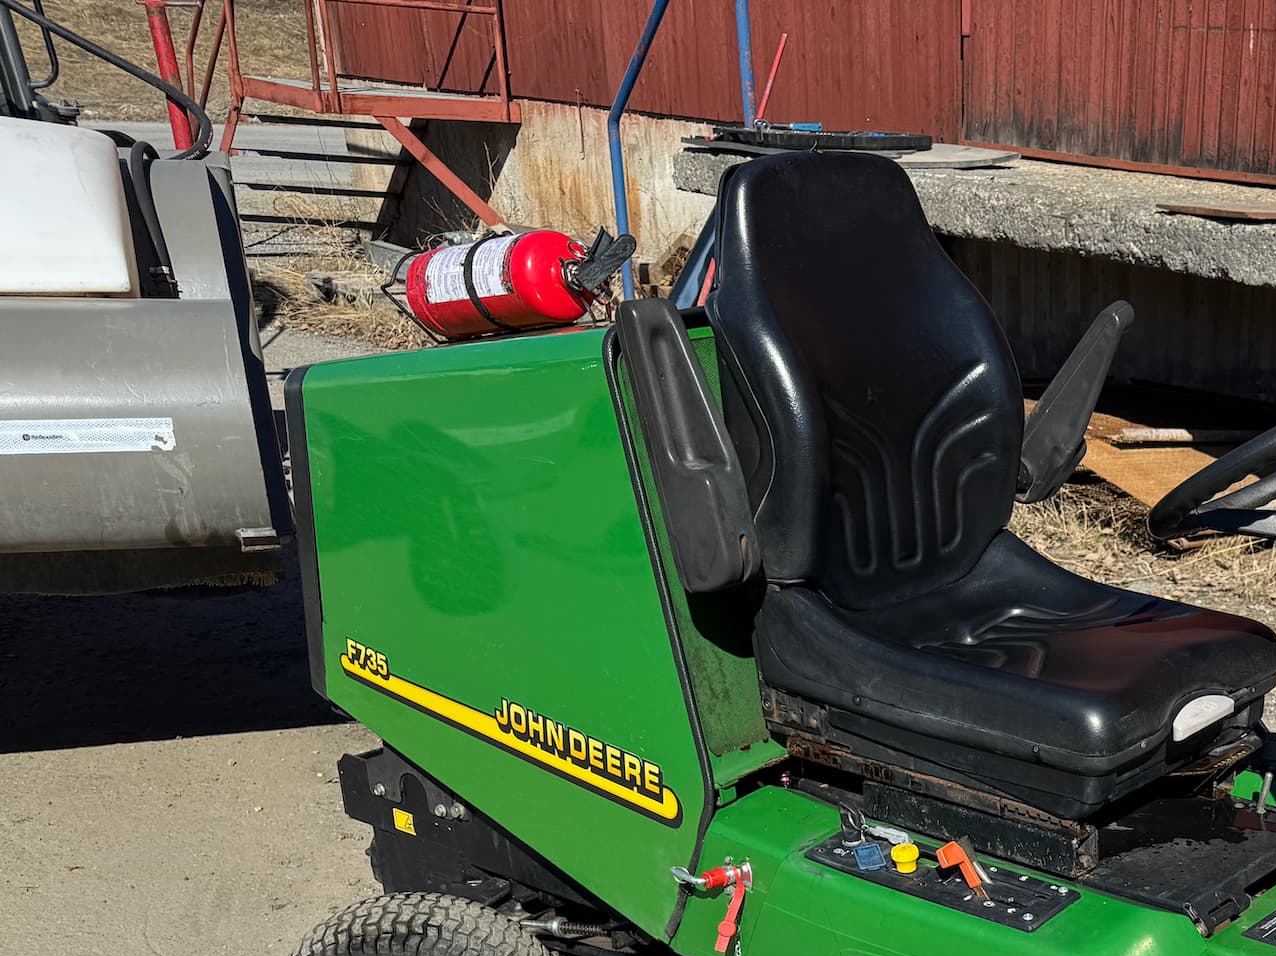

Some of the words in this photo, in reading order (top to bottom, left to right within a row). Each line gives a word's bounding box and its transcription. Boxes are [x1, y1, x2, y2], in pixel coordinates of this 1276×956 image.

[346, 638, 388, 676] F735
[495, 699, 564, 752] JOHN
[569, 728, 662, 793] DEERE
